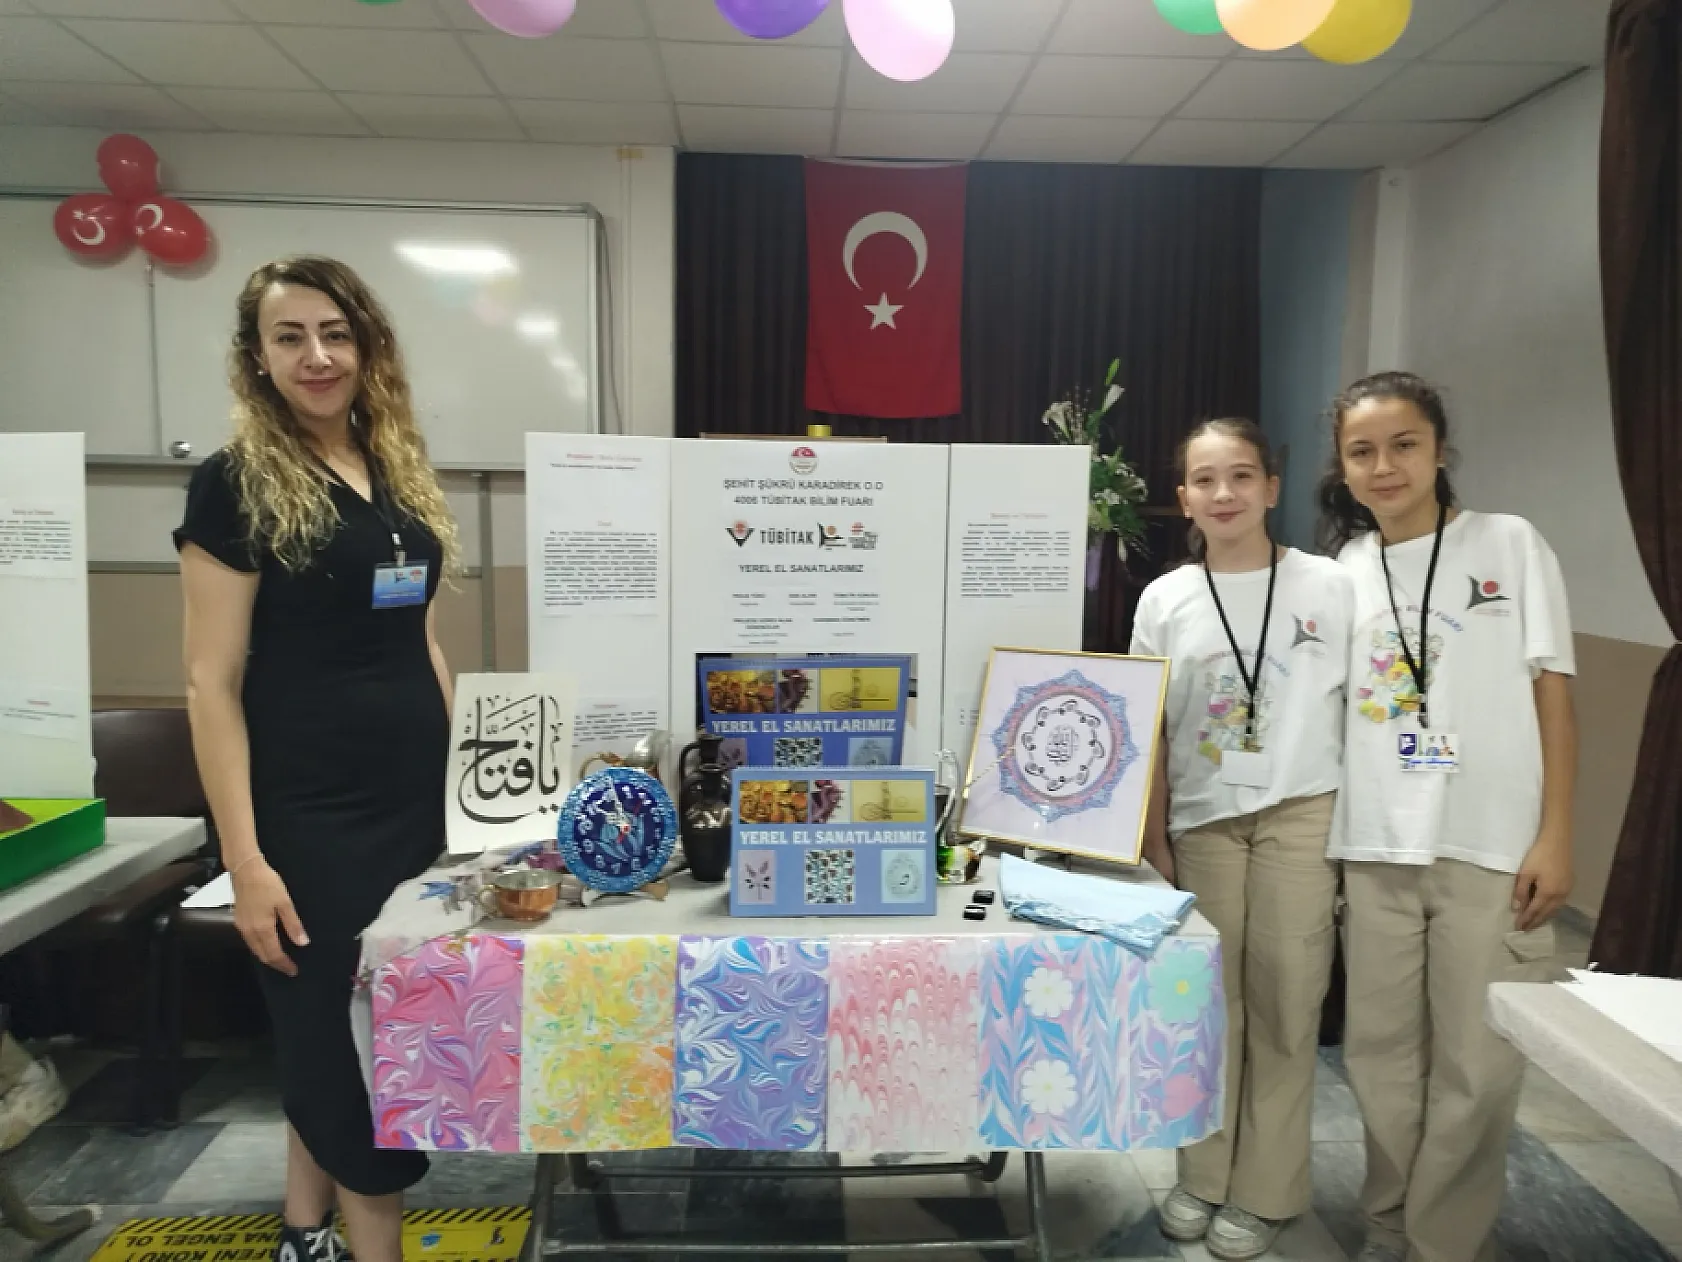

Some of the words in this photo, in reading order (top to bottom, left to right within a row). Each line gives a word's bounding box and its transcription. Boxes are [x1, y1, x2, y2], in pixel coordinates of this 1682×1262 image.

[761, 495, 807, 505] TÜBİTAK
[809, 495, 838, 506] BİLİM
[840, 496, 875, 507] FUARI
[760, 527, 815, 545] TÜBİTAK
[738, 564, 772, 573] YEREL
[774, 564, 788, 573] EL
[790, 564, 865, 573] SANATLARIMIZ
[711, 719, 758, 733] YEREL
[761, 720, 781, 733] EL
[783, 718, 896, 732] SANATLARIMIZ
[739, 830, 788, 845] YEREL
[792, 830, 812, 844] EL
[814, 829, 929, 845] SANATLARIMIZ
